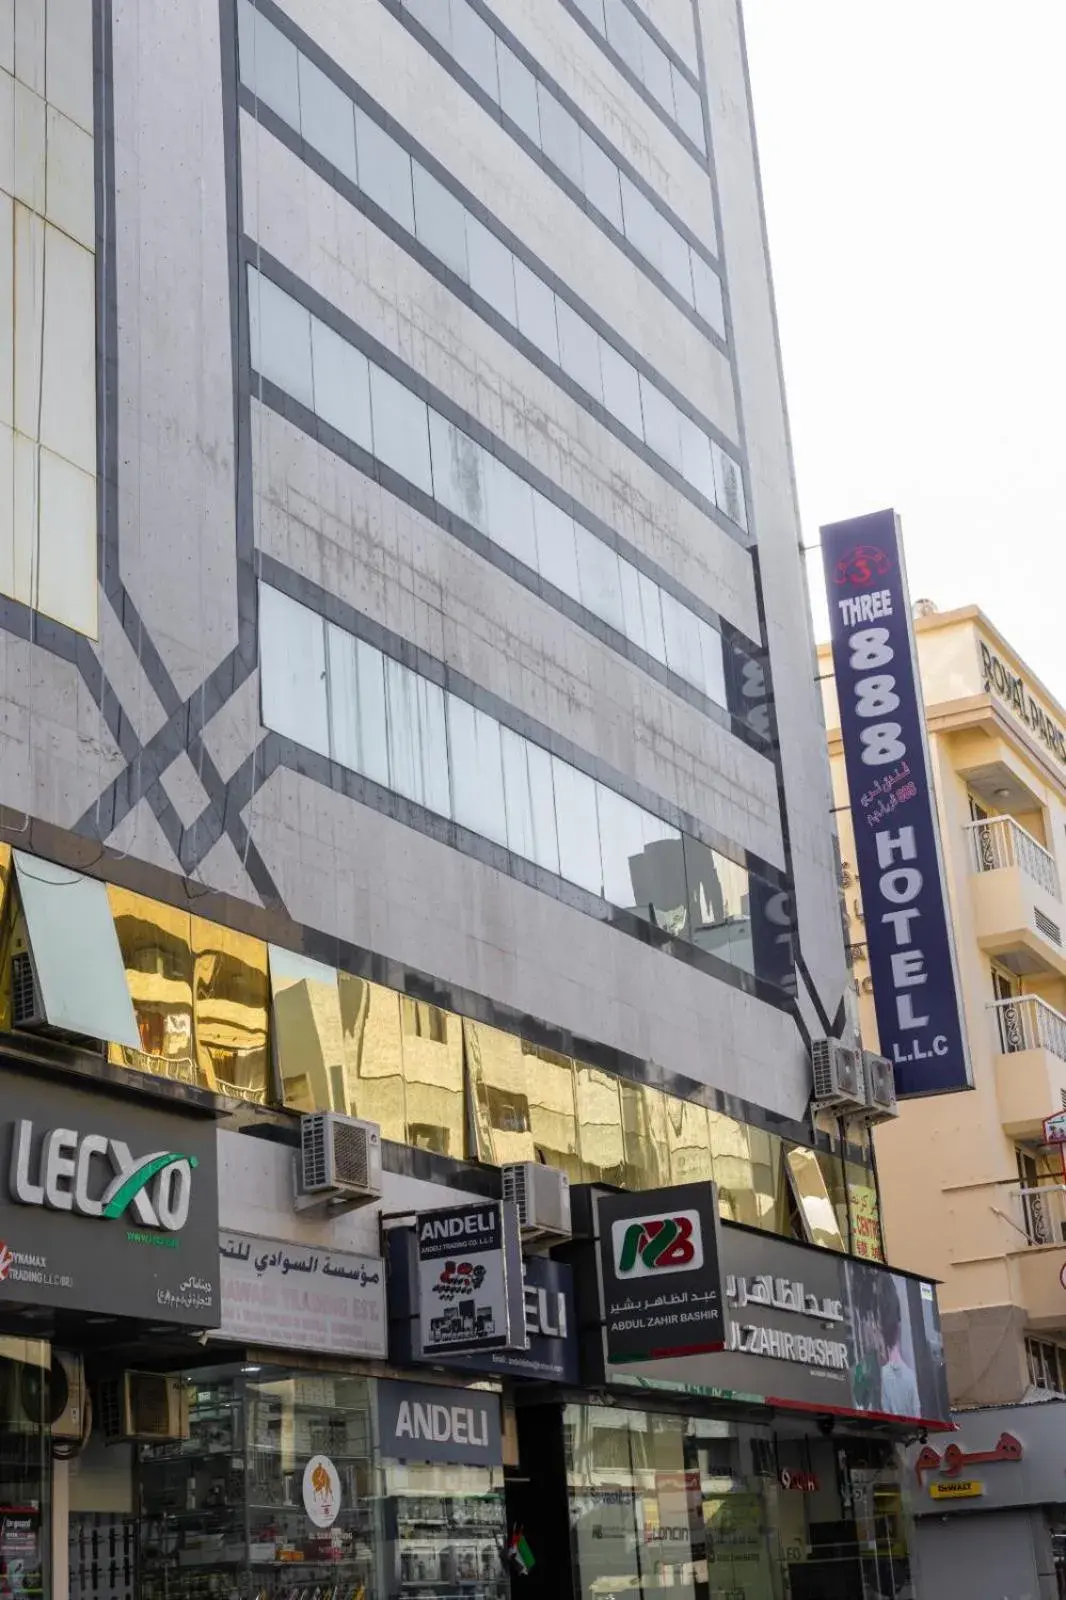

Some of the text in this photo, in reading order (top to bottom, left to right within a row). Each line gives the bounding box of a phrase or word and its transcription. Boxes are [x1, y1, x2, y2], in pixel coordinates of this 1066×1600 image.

[838, 589, 893, 627] THREE
[875, 825, 931, 1031] HOTEL
[893, 1035, 949, 1064] L.L.C
[420, 1211, 495, 1241] ANDELI
[9, 1268, 43, 1283] TRADING
[254, 1251, 319, 1279] السوادي
[322, 1256, 380, 1288] مؤسسة
[611, 1309, 719, 1332] ABDUL ZAHIR BASHIR
[744, 1324, 796, 1361] ZAHIR
[797, 1335, 849, 1369] BASHIR
[395, 1400, 489, 1447] ANDELI
